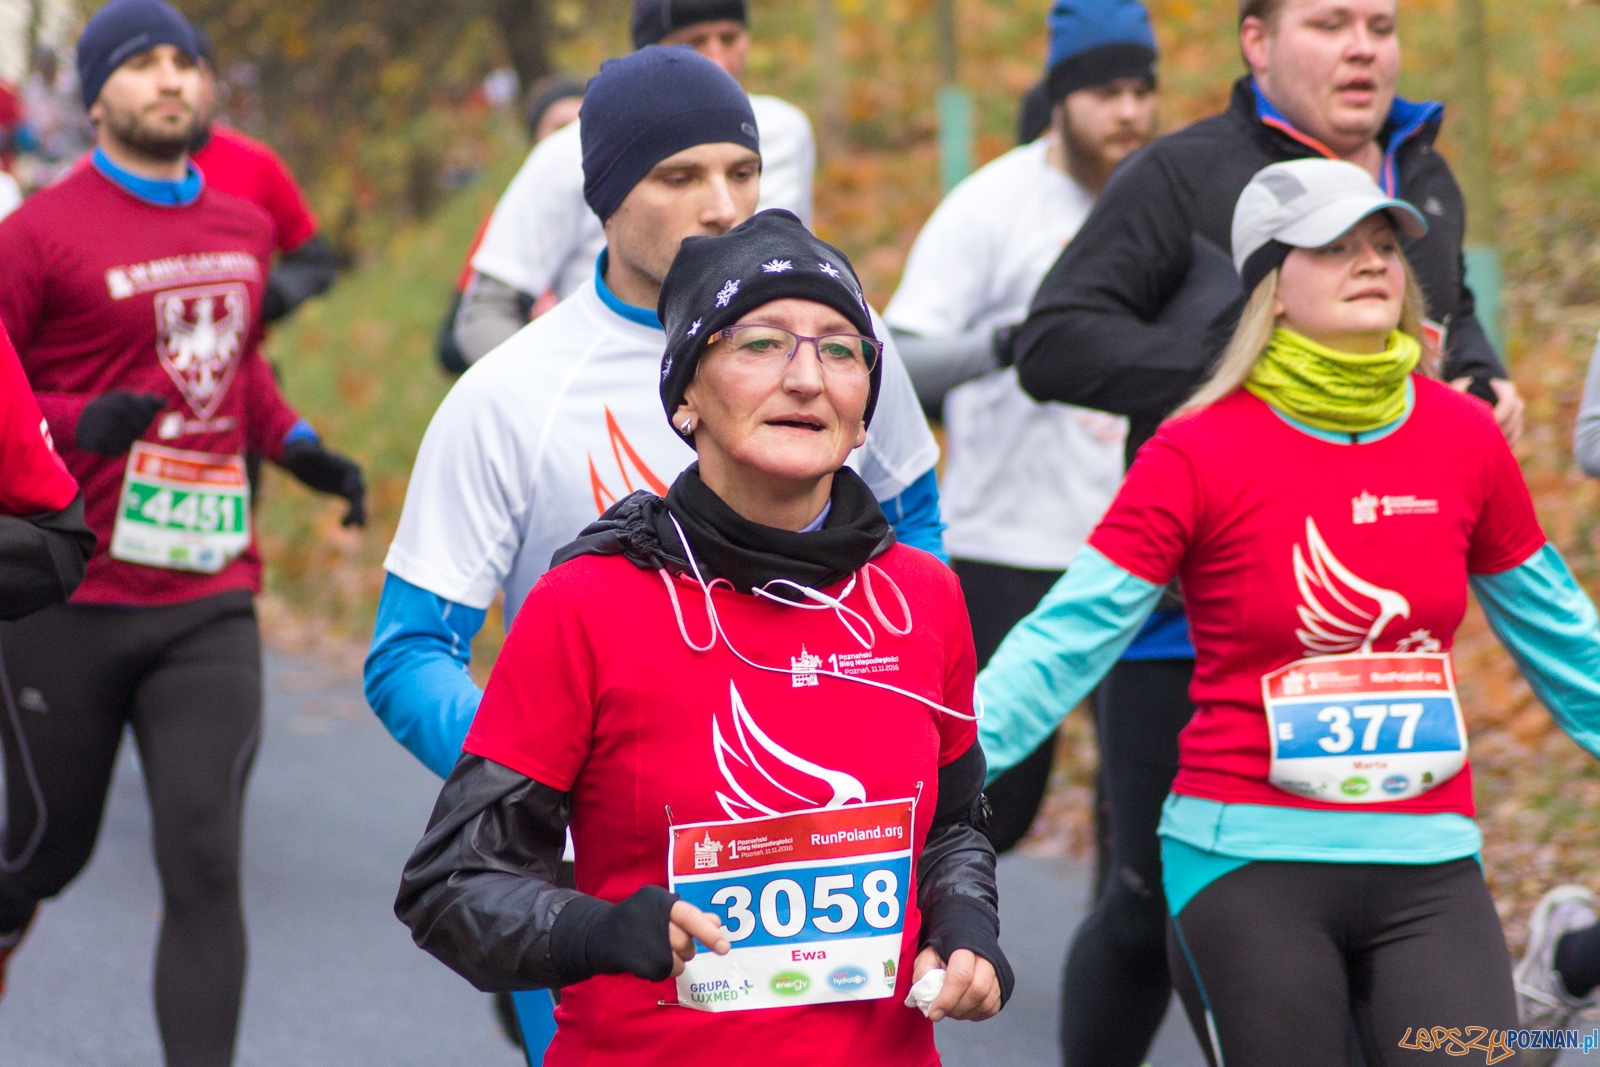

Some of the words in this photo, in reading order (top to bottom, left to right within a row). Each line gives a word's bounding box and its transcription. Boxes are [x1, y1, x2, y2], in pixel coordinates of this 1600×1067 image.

[141, 488, 235, 530] 4451
[838, 651, 872, 660] Poznański
[828, 653, 842, 675] 1
[839, 659, 854, 668] Bieg
[871, 664, 900, 673] 11.11.2016
[1316, 702, 1424, 754] 377
[737, 836, 768, 845] Poznański
[811, 825, 903, 846] RunPoland.org
[751, 837, 793, 849] Niepodległości
[727, 840, 740, 860] 1
[765, 845, 794, 855] 11.11.2016
[710, 868, 900, 943] 3058
[791, 949, 827, 962] Ewa
[690, 979, 730, 993] GRUPA
[775, 980, 808, 991] energy
[691, 990, 738, 1003] LUXMED
